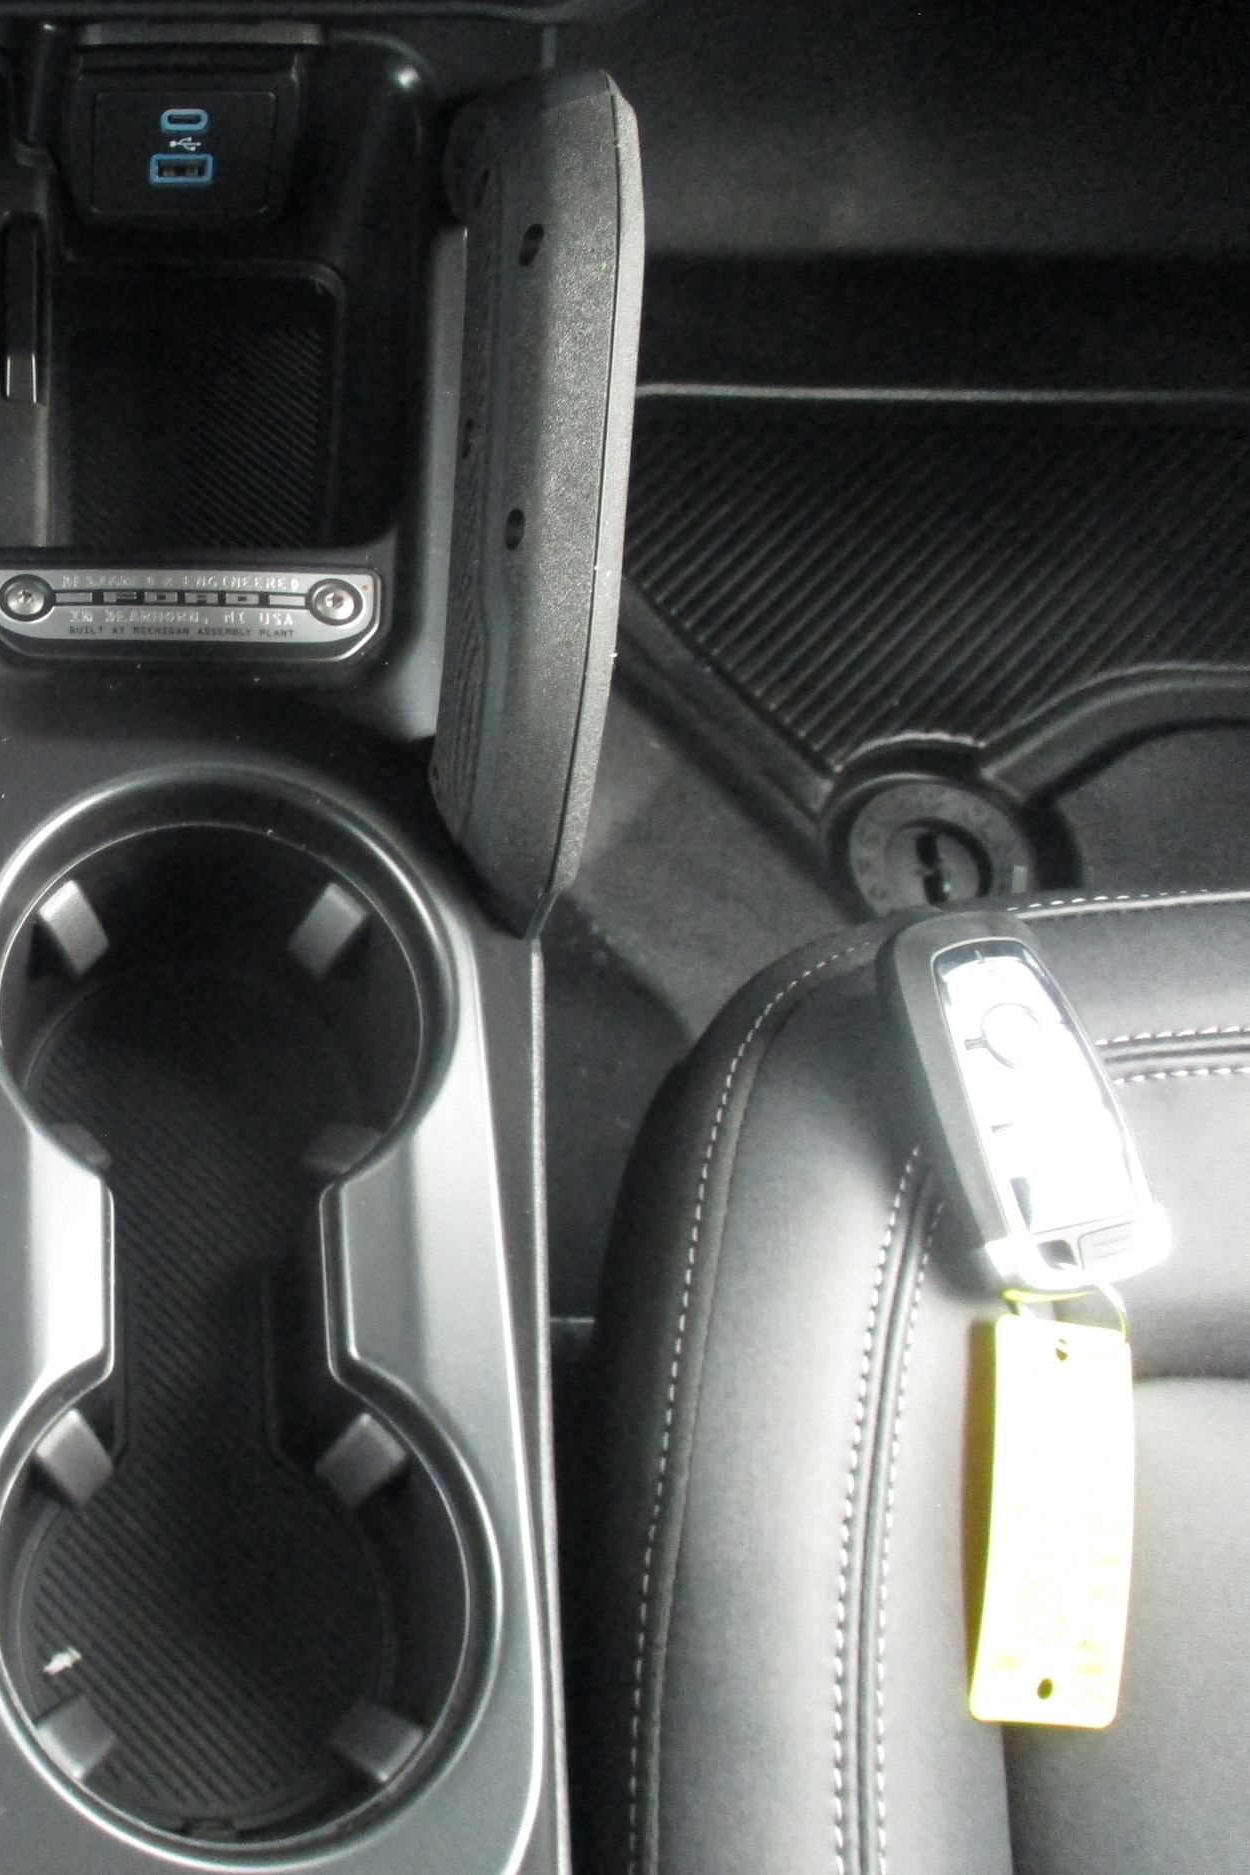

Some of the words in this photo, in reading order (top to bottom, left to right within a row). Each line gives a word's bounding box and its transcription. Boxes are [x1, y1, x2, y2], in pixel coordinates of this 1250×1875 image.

[182, 575, 300, 591] ENGINEERED
[259, 612, 294, 626] USA
[70, 625, 104, 636] BUILT
[112, 625, 126, 636] AT
[197, 627, 251, 638] ASSEMBLY
[259, 628, 295, 639] PLANT
